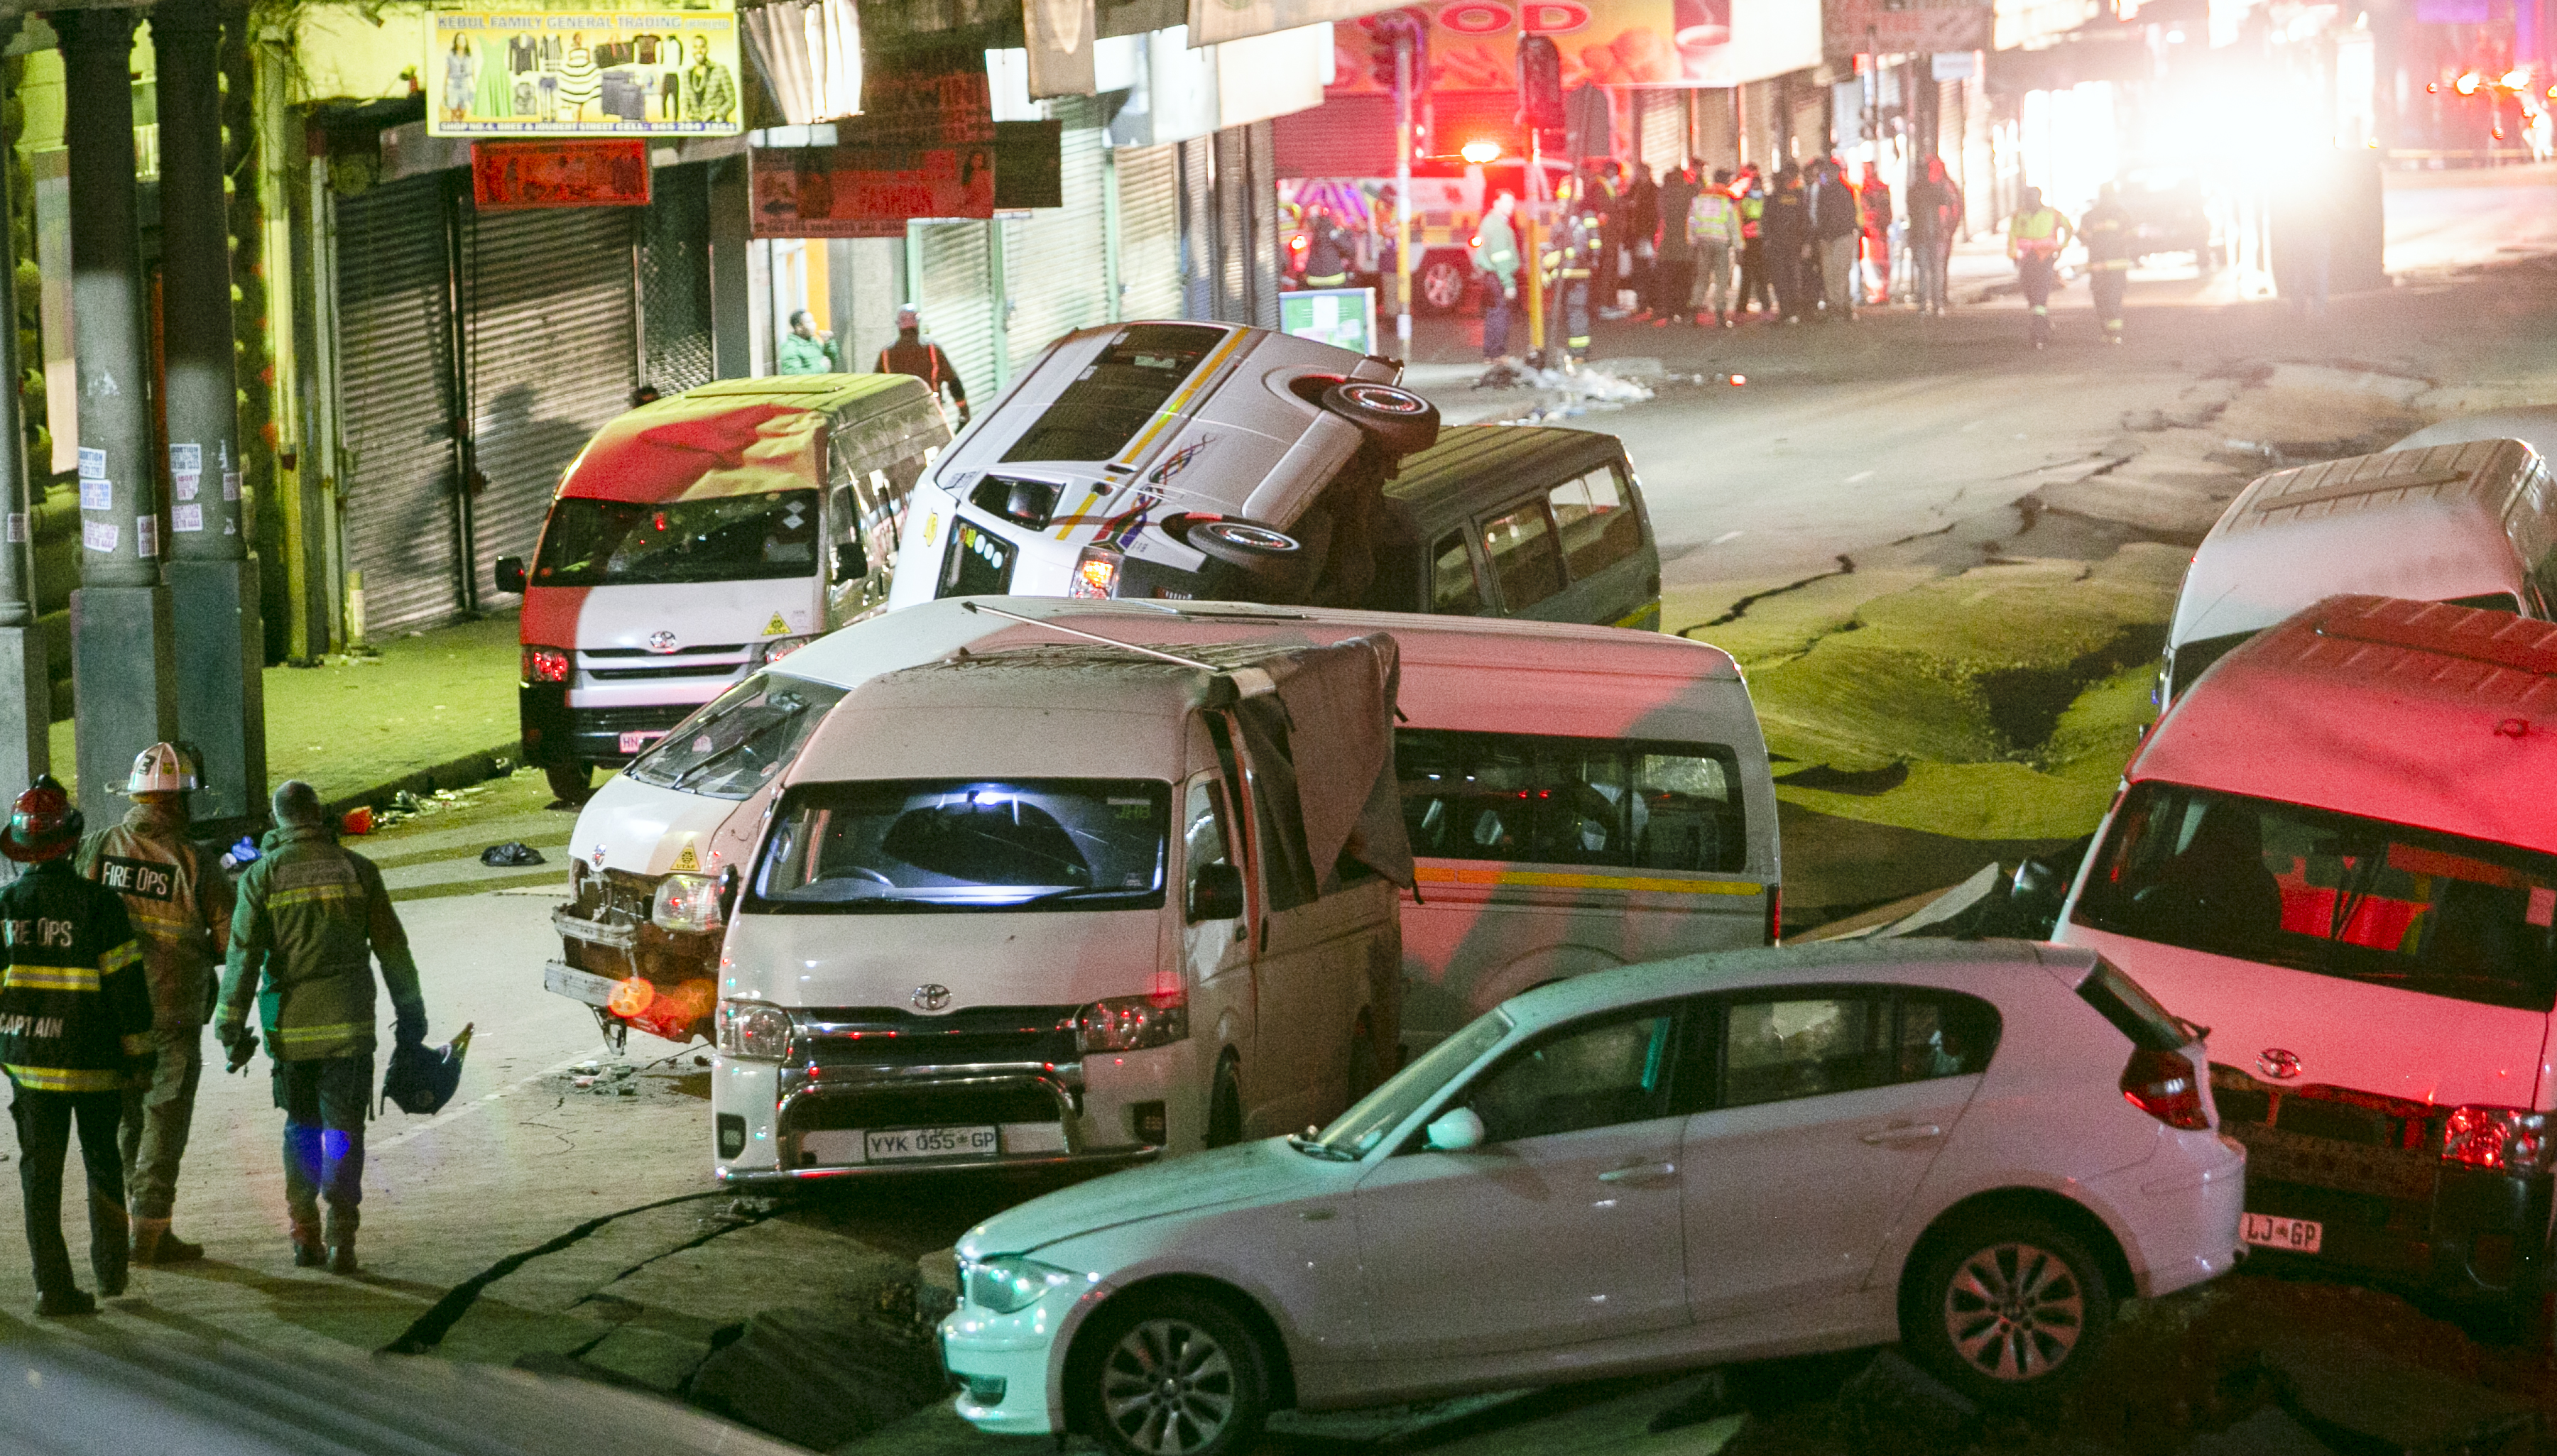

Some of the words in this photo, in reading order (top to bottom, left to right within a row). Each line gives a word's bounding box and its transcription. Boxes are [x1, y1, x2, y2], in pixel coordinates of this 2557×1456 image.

[437, 16, 486, 29] KEBUL
[490, 16, 542, 28] FAMILY
[546, 16, 614, 28] GENERAL
[617, 16, 682, 28] TRADING
[440, 122, 467, 131] SHOP
[579, 122, 614, 131] STREET
[102, 861, 134, 888] FIRE
[136, 867, 168, 895] OPS
[38, 917, 72, 946] OPS
[871, 1137, 908, 1151] YYK
[915, 1134, 955, 1151] 055
[971, 1132, 994, 1148] GP
[2247, 1214, 2273, 1240] LJ
[2291, 1222, 2315, 1246] GP
